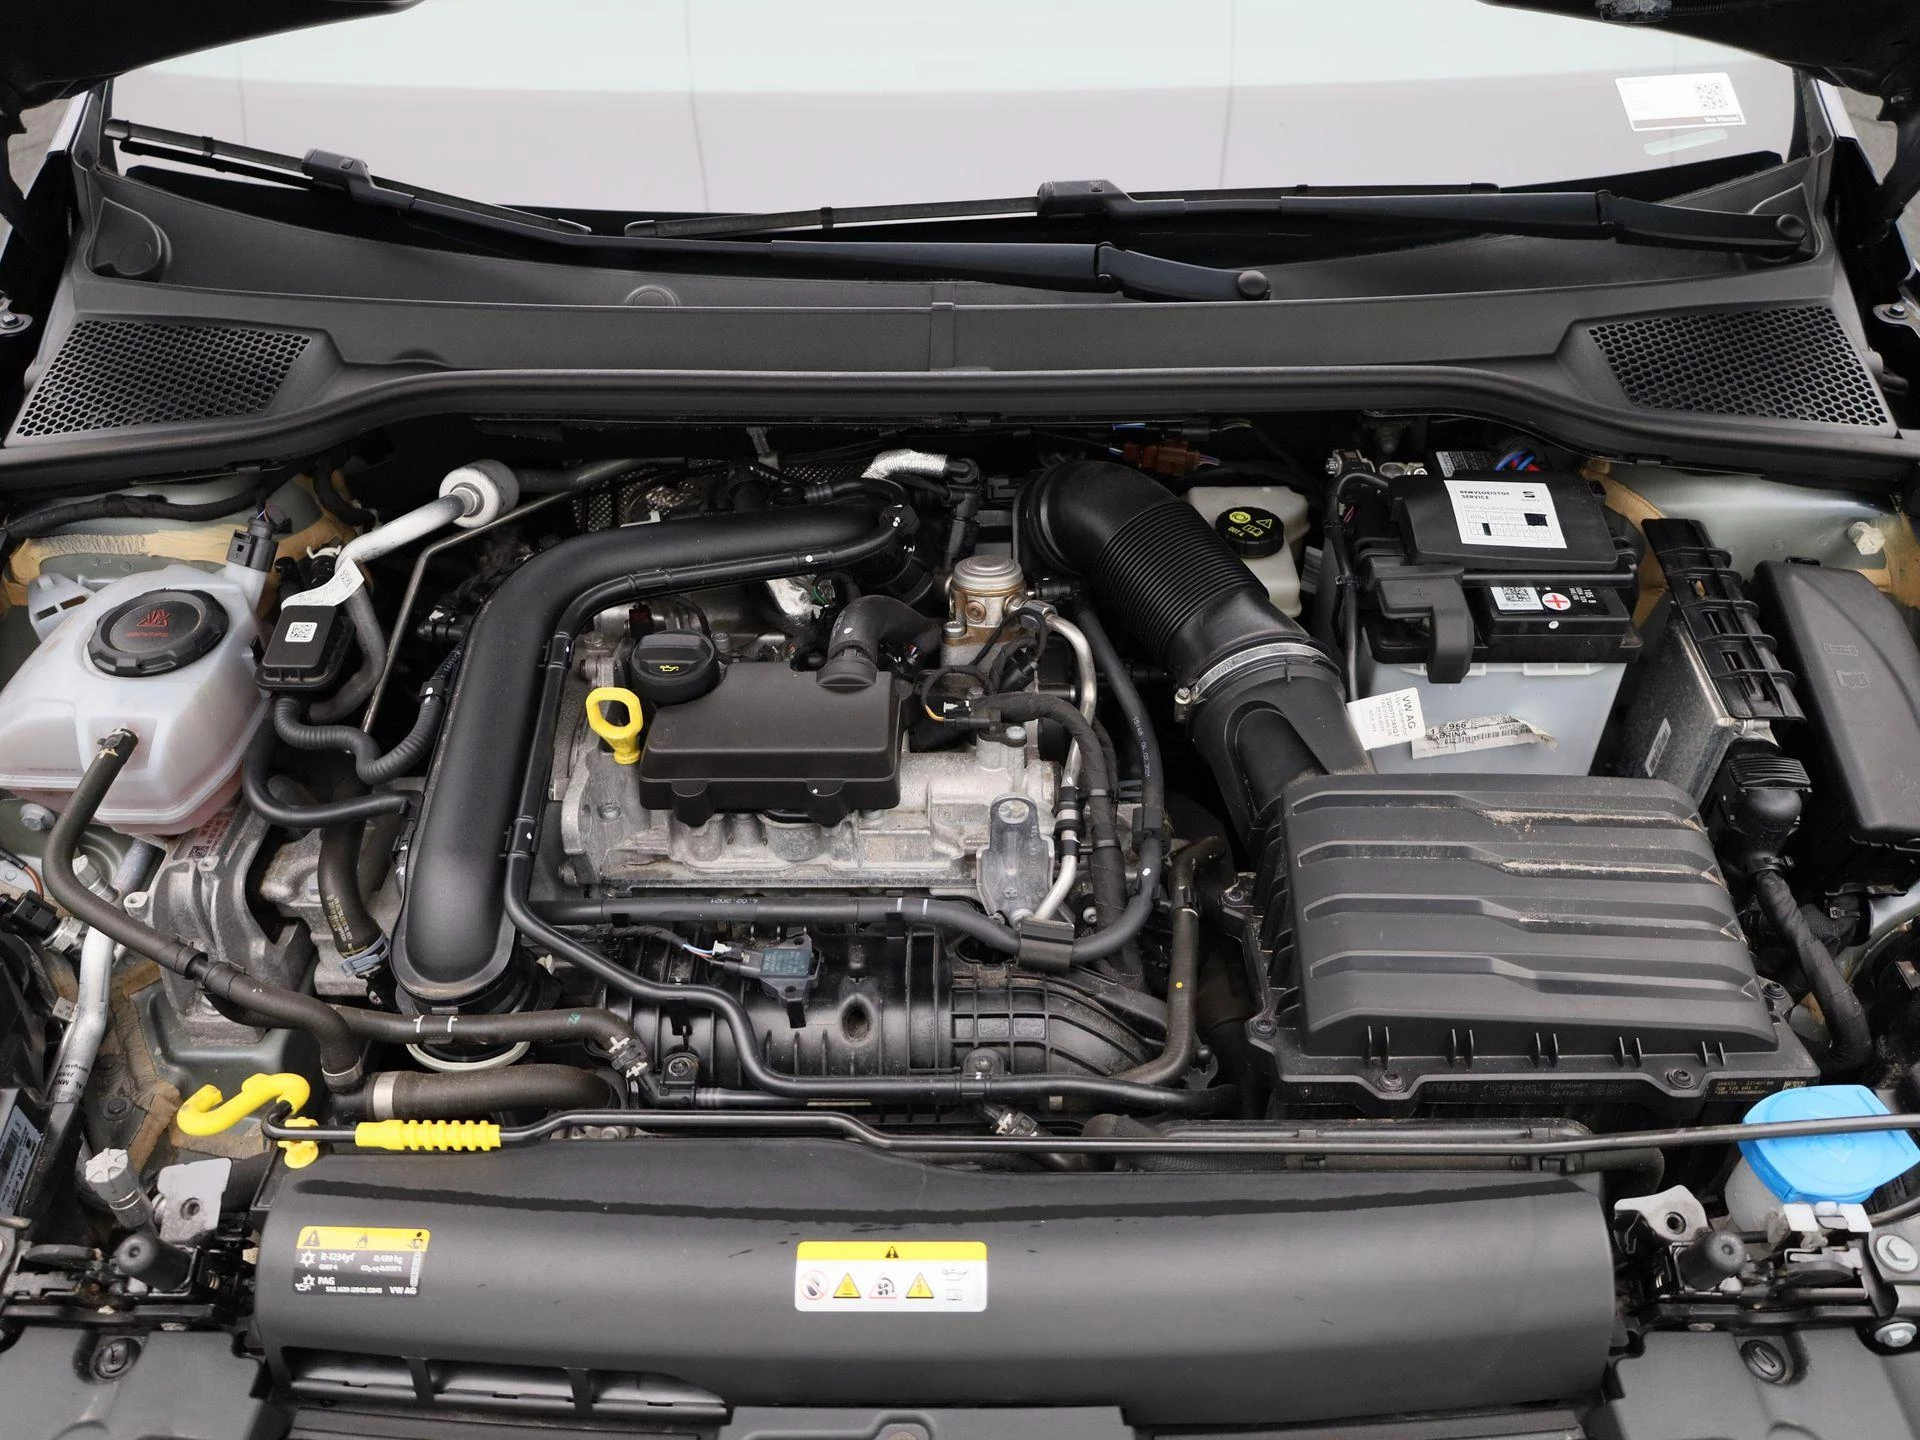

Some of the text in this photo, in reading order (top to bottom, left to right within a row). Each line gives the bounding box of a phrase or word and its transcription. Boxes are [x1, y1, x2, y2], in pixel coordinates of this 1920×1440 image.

[1402, 695, 1416, 730] VW AG
[320, 1252, 356, 1263] R-1234yf
[317, 1276, 336, 1286] PAG
[389, 1286, 404, 1294] VW
[403, 1286, 418, 1295] AG
